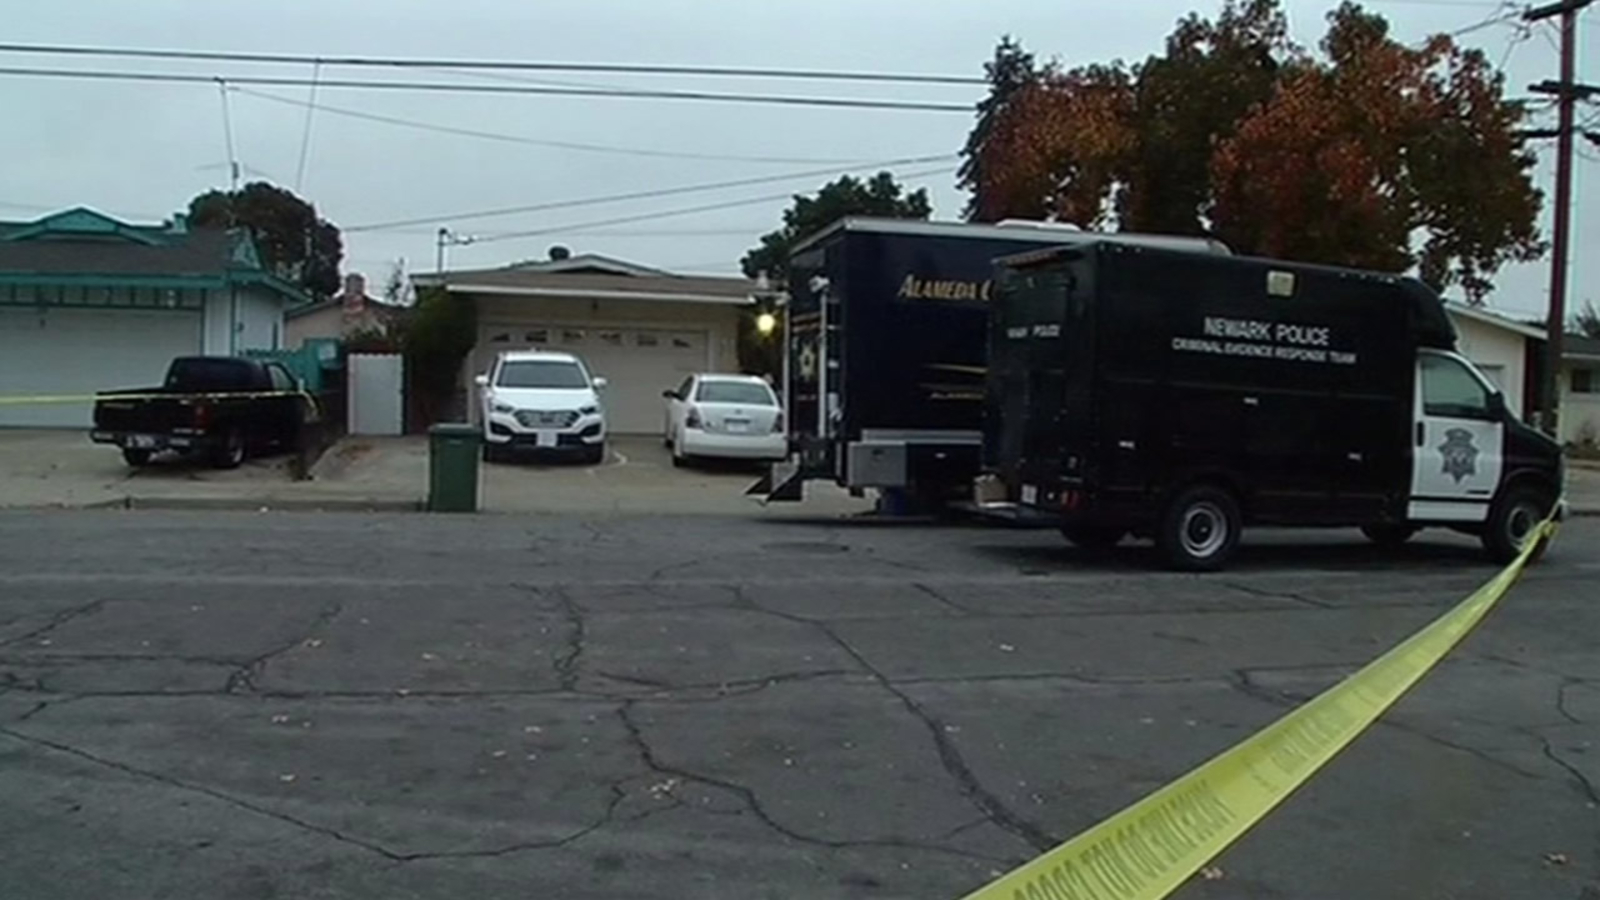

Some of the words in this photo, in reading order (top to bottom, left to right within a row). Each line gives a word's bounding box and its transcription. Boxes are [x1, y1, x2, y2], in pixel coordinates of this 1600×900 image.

[898, 273, 977, 300] ALAMEDA
[1204, 316, 1271, 340] NEWARK
[1276, 323, 1329, 347] POLICE
